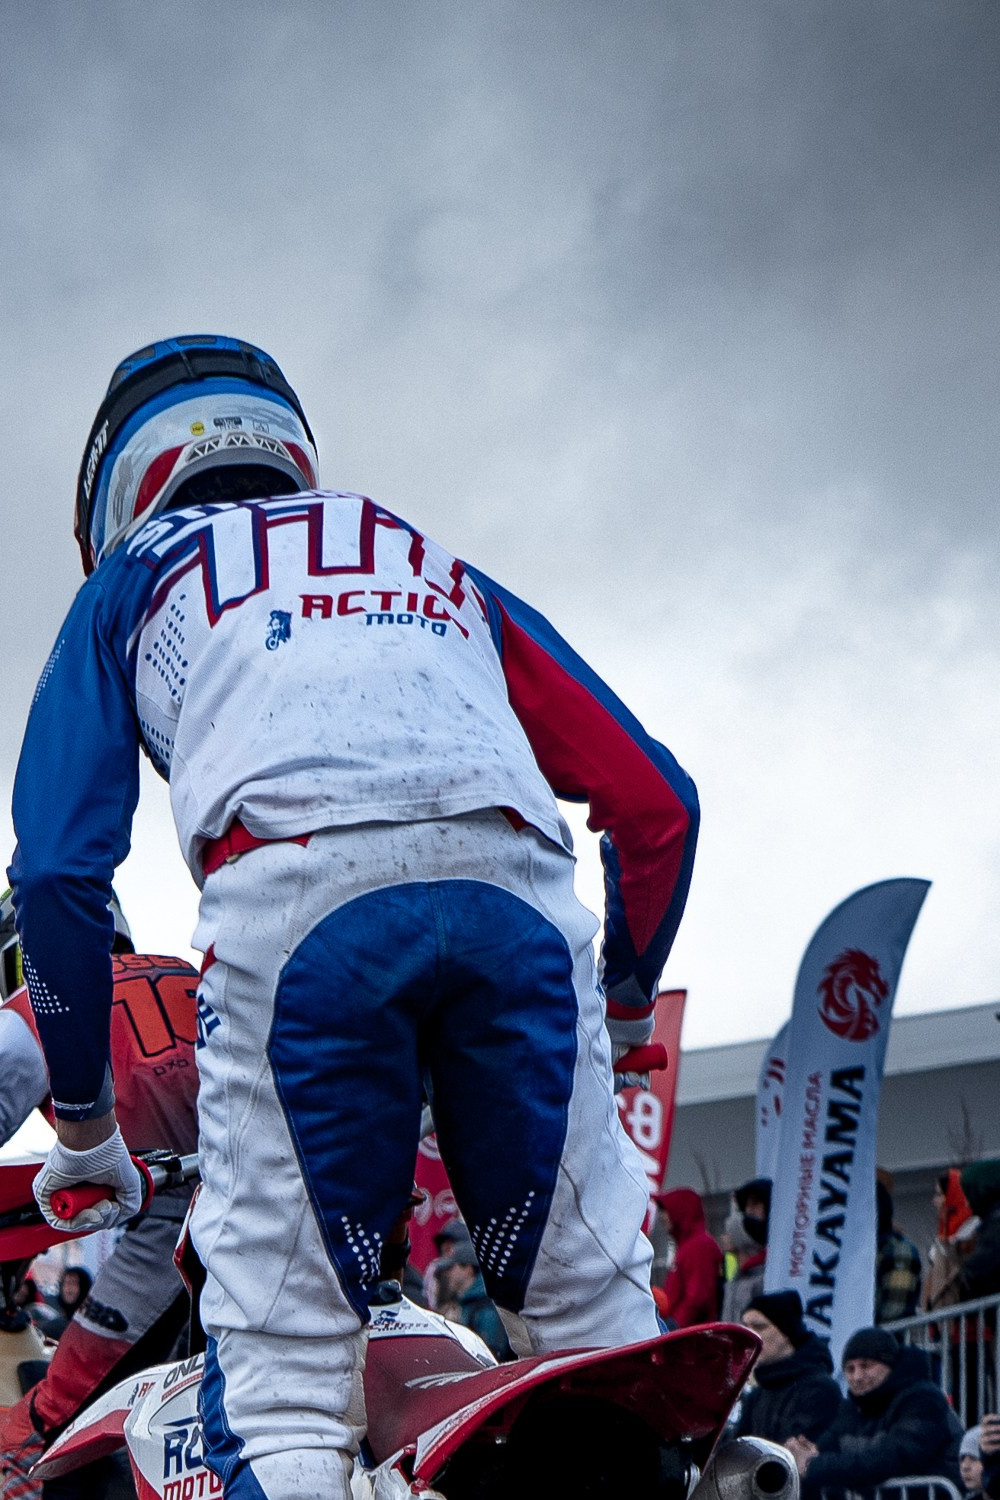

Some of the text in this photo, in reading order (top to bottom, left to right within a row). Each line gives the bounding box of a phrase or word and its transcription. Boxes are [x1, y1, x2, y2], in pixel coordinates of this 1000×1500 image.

[298, 589, 470, 640] ACTIO
[365, 613, 448, 637] MOTO
[803, 1070, 822, 1150] МАСЛА
[806, 1064, 866, 1328] AKAYAMA
[163, 1356, 203, 1389] ONL
